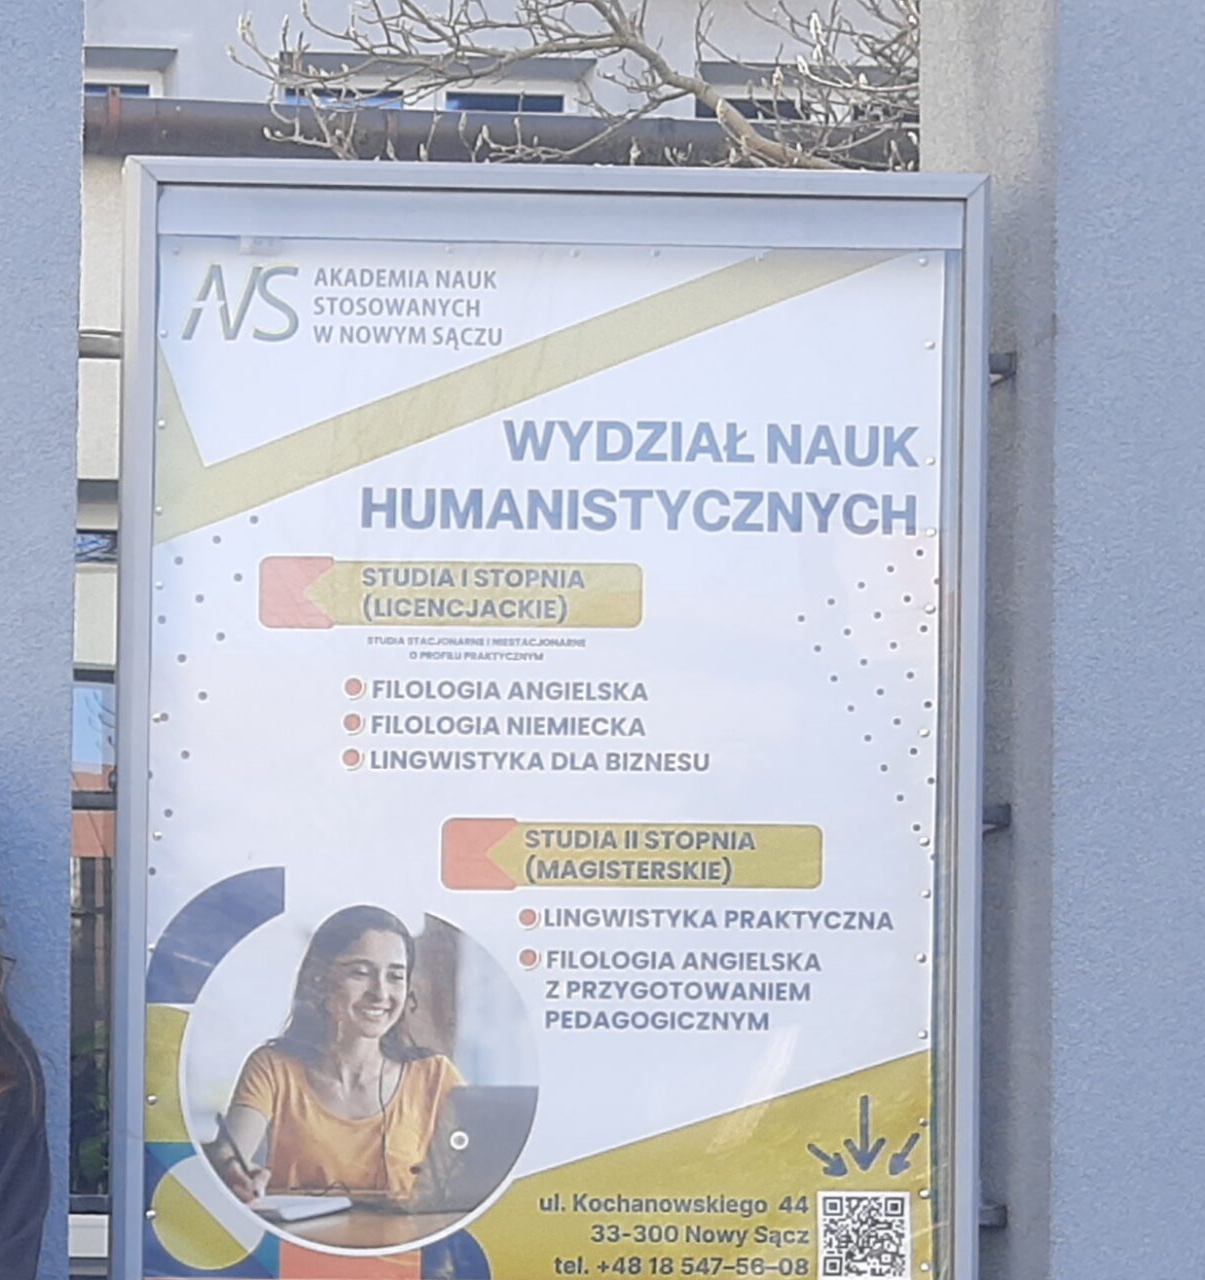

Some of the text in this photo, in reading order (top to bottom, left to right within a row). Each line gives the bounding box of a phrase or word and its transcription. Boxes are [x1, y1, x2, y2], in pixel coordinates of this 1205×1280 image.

[314, 268, 497, 289] AKADEMIA NAUK
[313, 297, 480, 317] STOSOWANYCH
[313, 326, 502, 350] W NOWYM SĄCZU
[503, 420, 920, 467] WYDZIAŁ NAUK
[361, 487, 917, 536] HUMANISTYCZNYCH
[362, 568, 585, 588] STUDIA I STOPNIA
[362, 594, 568, 624] (LICENCJACKIE)
[372, 680, 648, 701] FILOLOGIA ANGIELSKA
[371, 715, 645, 736] FILOLOGIA NIEMIECKA
[370, 751, 709, 772] LINGWISTYKA DLA BIZNESU
[525, 830, 755, 850] STUDIA II STOPNIA
[525, 855, 732, 885] (MAGISTERSKIE)
[544, 908, 894, 930] LINGWISTYKA PRAKTYCZNA
[546, 950, 821, 971] FILOLOGIA ANGIELSKA
[546, 981, 810, 1001] Z PRZYGOTOWANIEM
[545, 1011, 768, 1030] PEDAGOGICZNYM
[539, 1194, 809, 1218] ul. Kochanowskiego 44
[590, 1224, 809, 1248] 33-300 Nowy Sącz
[555, 1257, 589, 1274] tel.
[596, 1258, 642, 1275] +48
[650, 1258, 674, 1275] 18
